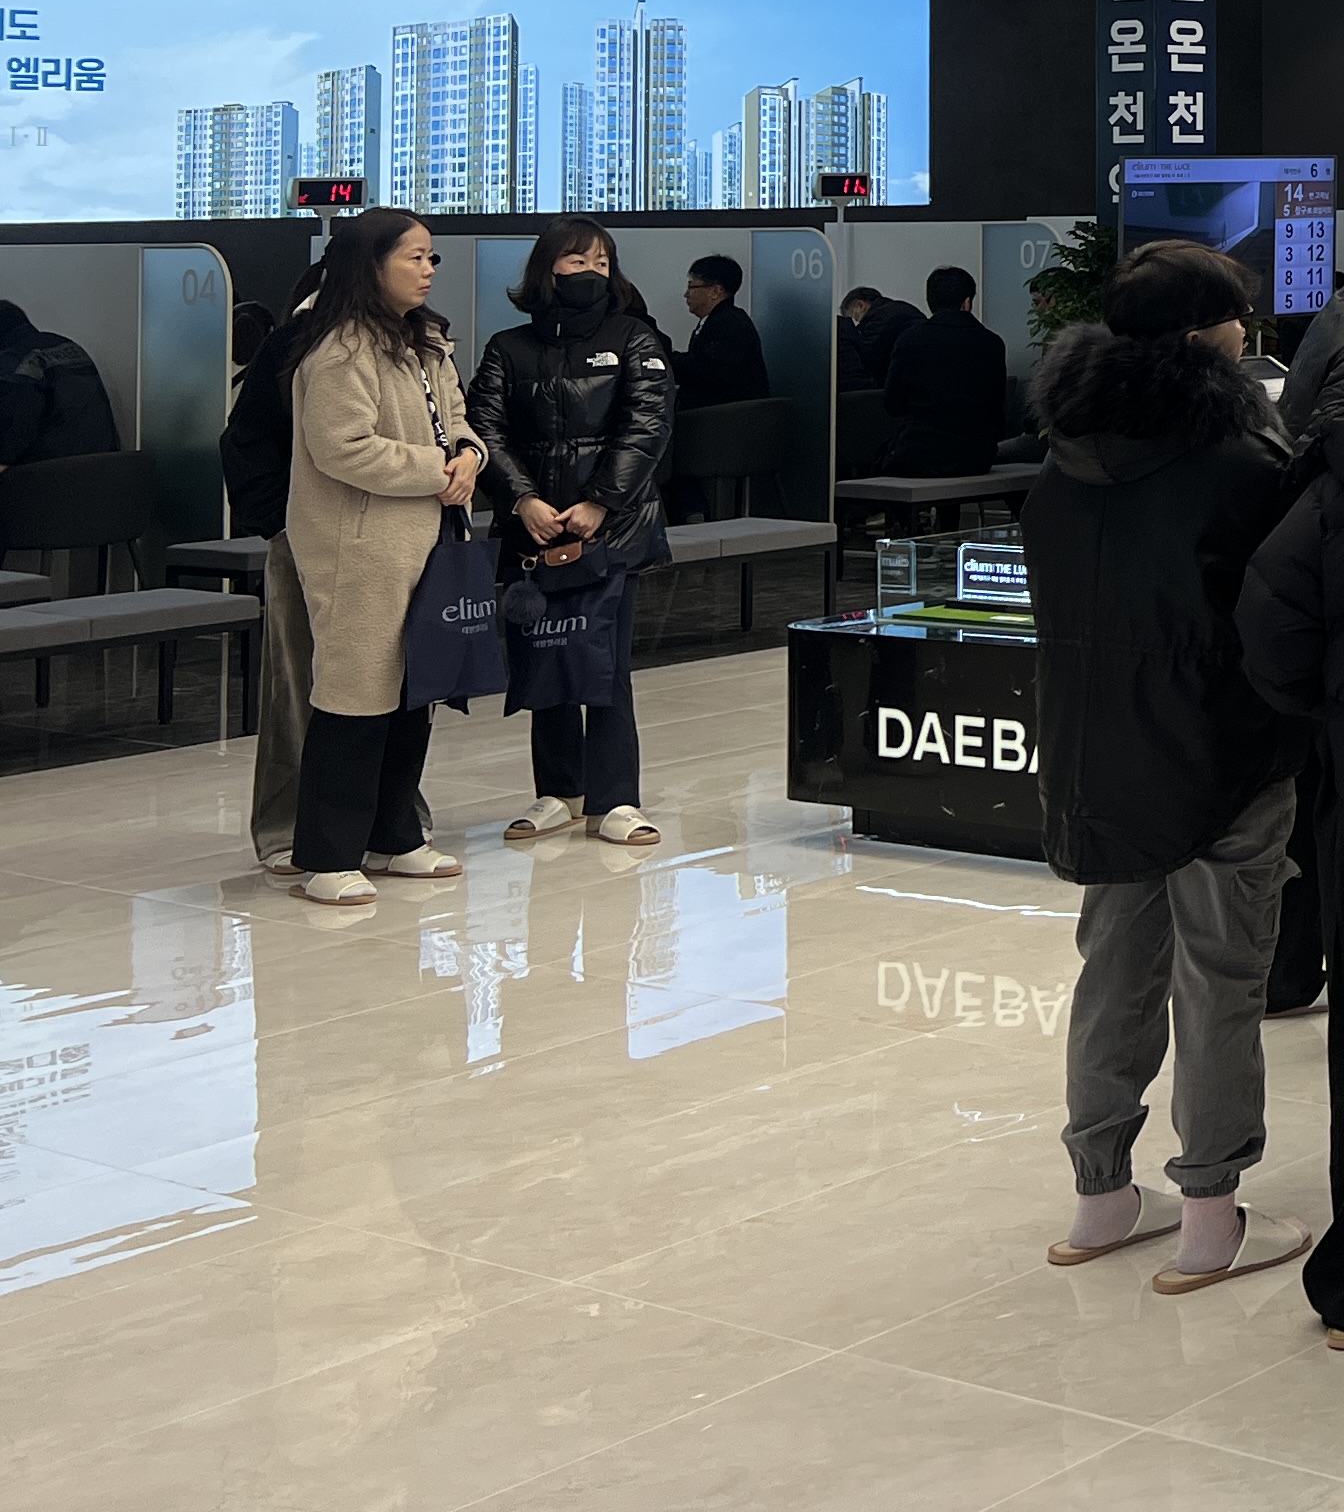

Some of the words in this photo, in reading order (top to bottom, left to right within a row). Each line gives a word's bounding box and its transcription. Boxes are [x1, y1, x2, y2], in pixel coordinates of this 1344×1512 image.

[6, 56, 107, 92] 엘리움
[1309, 163, 1318, 178] 6
[329, 183, 352, 202] 14
[1283, 183, 1304, 202] 14
[1283, 204, 1291, 217] 5
[1284, 223, 1293, 238] 9
[1307, 221, 1325, 239] 13
[1019, 239, 1051, 269] 07
[1284, 246, 1293, 261] 3
[1306, 244, 1325, 261] 12
[791, 248, 825, 280] 06
[1284, 270, 1293, 285] 8
[1306, 268, 1324, 285] 11
[181, 268, 217, 305] 04
[1284, 293, 1293, 309] 5
[1306, 290, 1324, 309] 10
[964, 558, 994, 574] elium
[441, 597, 497, 623] elium
[521, 615, 588, 637] elium
